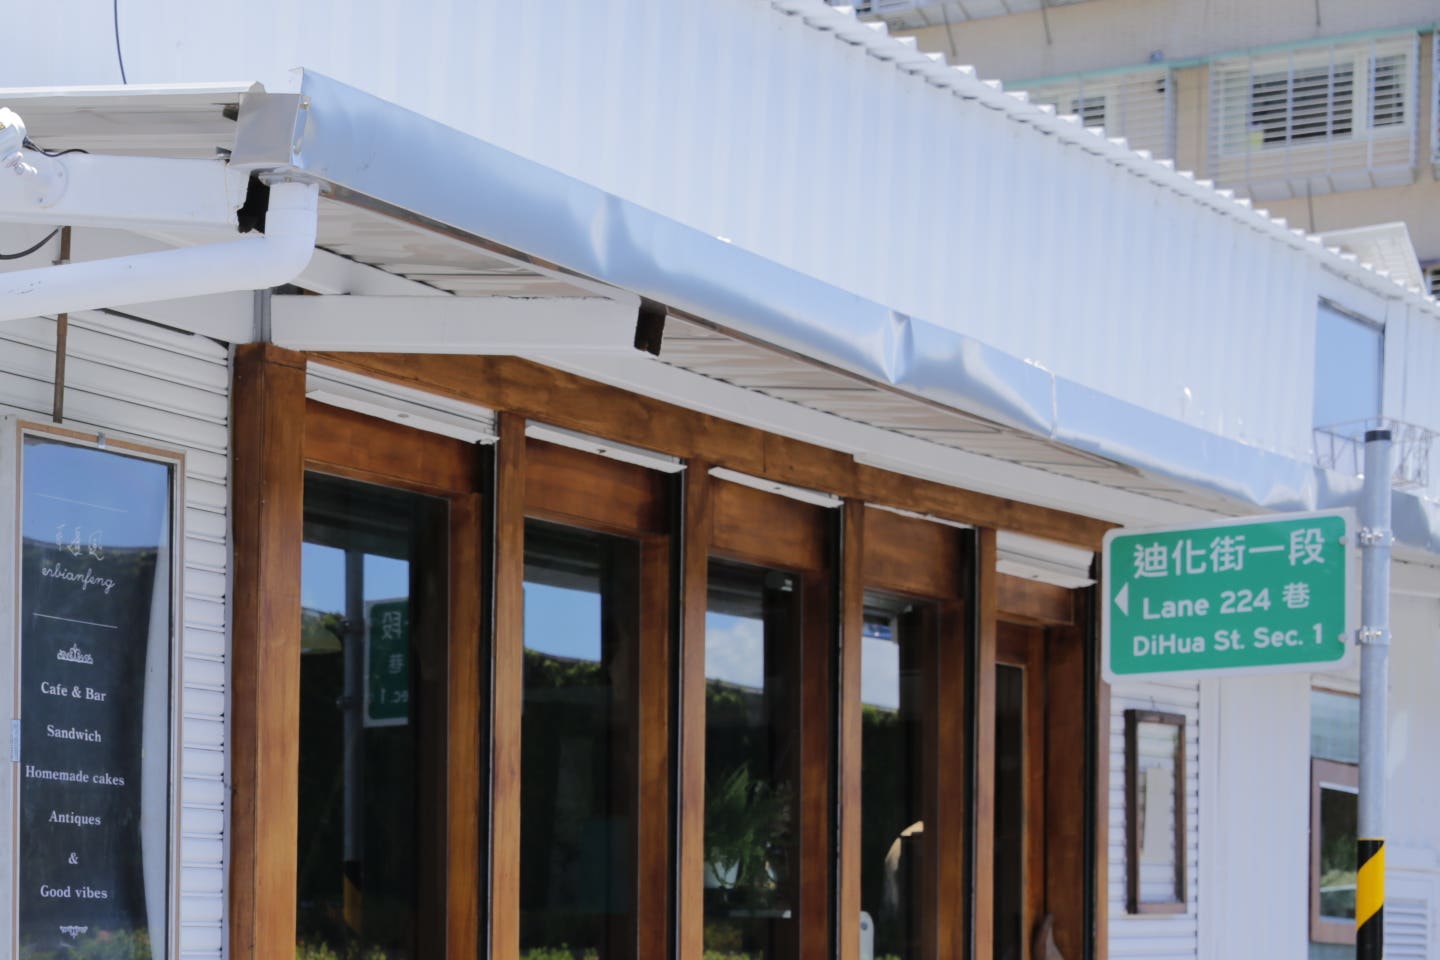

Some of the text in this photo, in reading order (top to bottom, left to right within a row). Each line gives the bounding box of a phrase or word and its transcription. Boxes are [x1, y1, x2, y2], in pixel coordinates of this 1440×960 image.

[1133, 528, 1325, 579] 迪化街一段
[41, 562, 116, 594] erbianfeng
[1143, 582, 1311, 620] Lane 224 巷
[1133, 623, 1323, 656] DiHua St. Sec. 1
[41, 681, 106, 702] Cafe & Bar
[47, 724, 102, 743] Sandwich
[25, 765, 125, 787] Homemade cakes
[48, 810, 101, 827] Antiques
[68, 852, 79, 865] &
[40, 884, 108, 900] Good vibes
